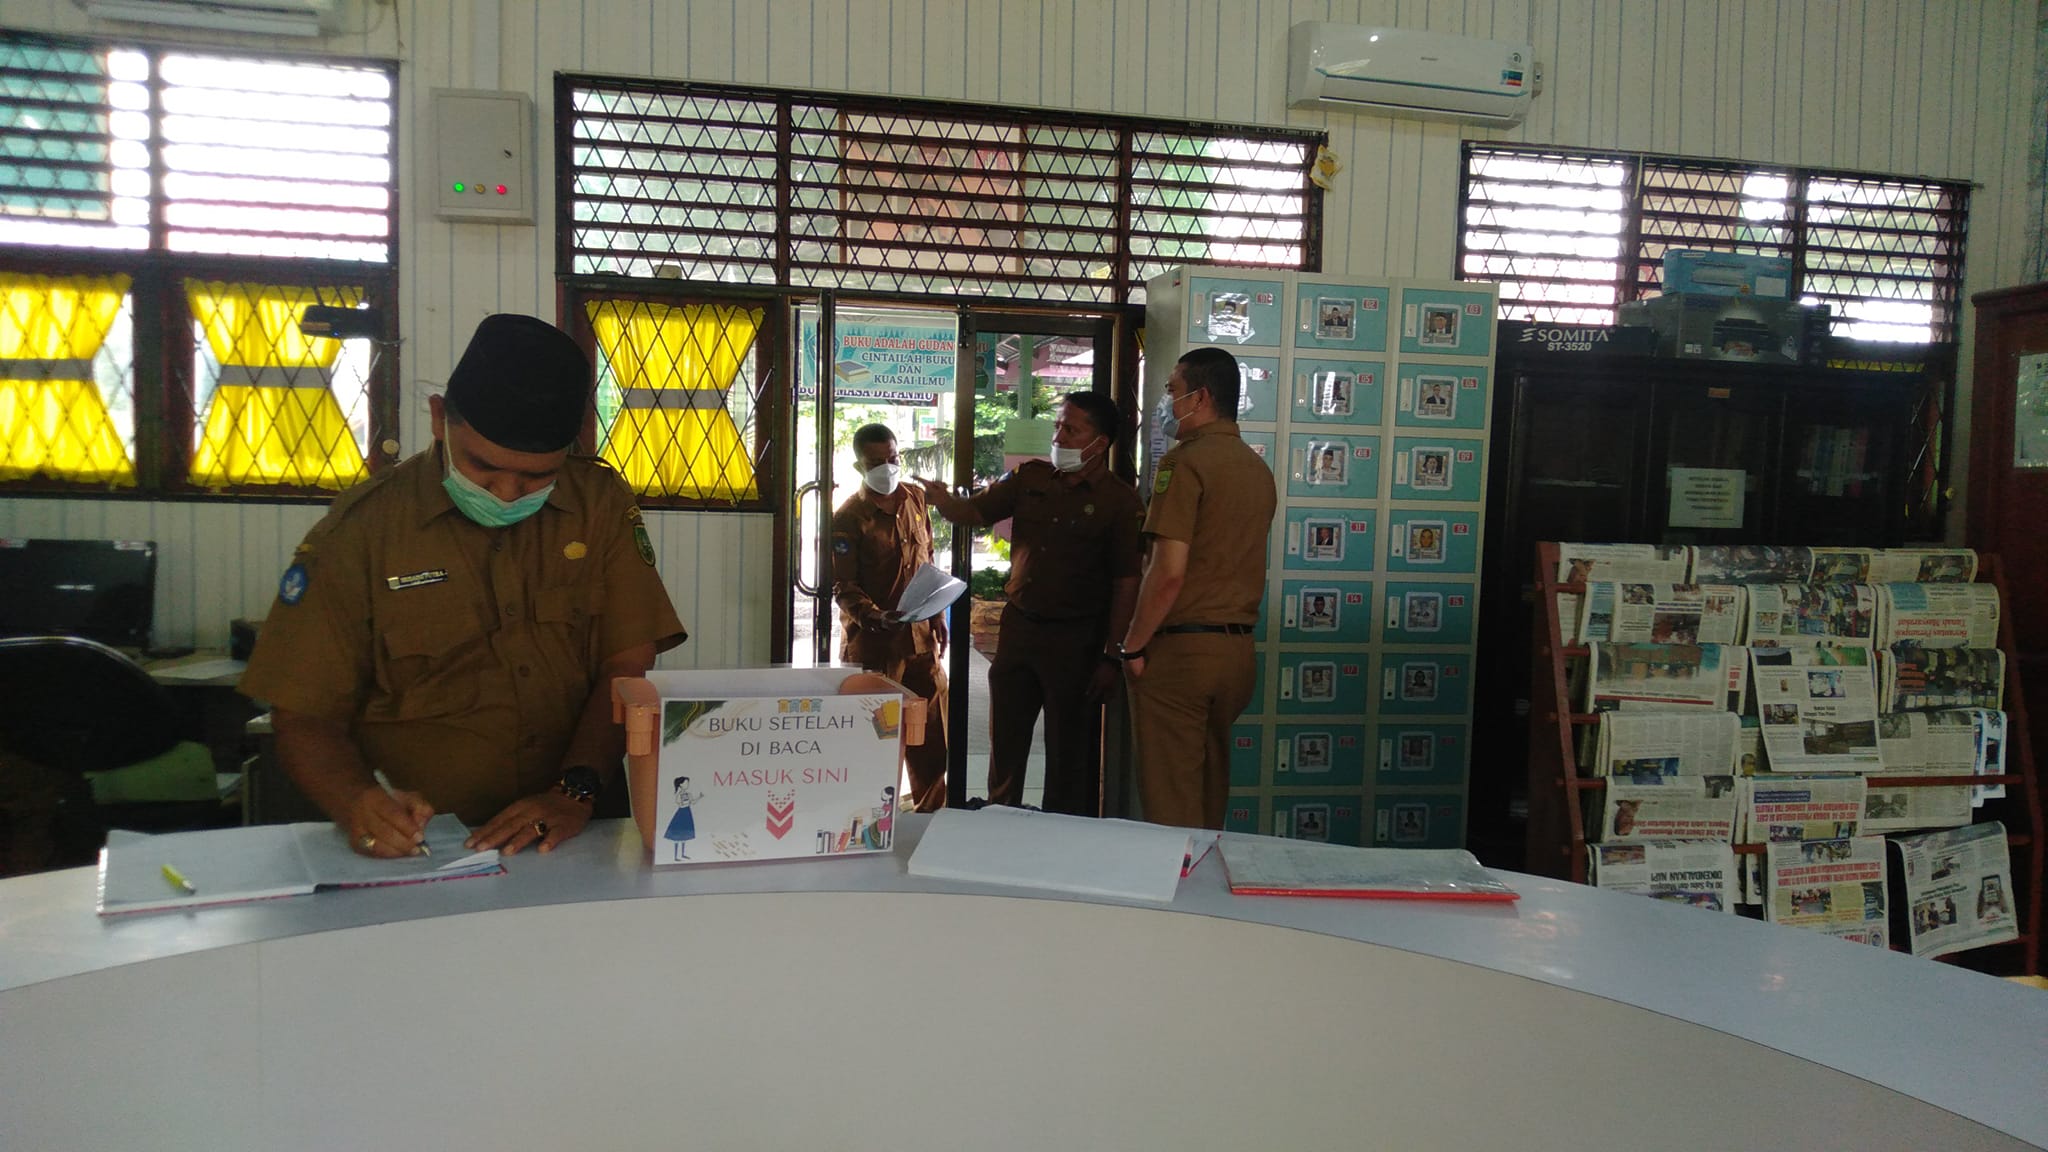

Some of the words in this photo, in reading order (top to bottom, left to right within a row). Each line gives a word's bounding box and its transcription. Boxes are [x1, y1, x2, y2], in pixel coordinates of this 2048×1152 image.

[1537, 329, 1609, 342] SOMITA
[843, 336, 871, 347] BUKU
[874, 337, 915, 350] ADALAH
[919, 339, 955, 351] GUDAN
[1547, 342, 1592, 352] ST-3520
[861, 353, 923, 364] CINTAILAH
[926, 354, 954, 365] BUKU
[899, 365, 922, 374] DAN
[874, 375, 916, 385] KUASAI
[918, 376, 946, 386] ILMU
[709, 717, 762, 732] BUKU
[768, 714, 854, 731] SETELAH
[741, 742, 760, 756] DI
[769, 740, 822, 755] BACA
[713, 769, 794, 787] MASUK
[802, 767, 848, 784] SINI
